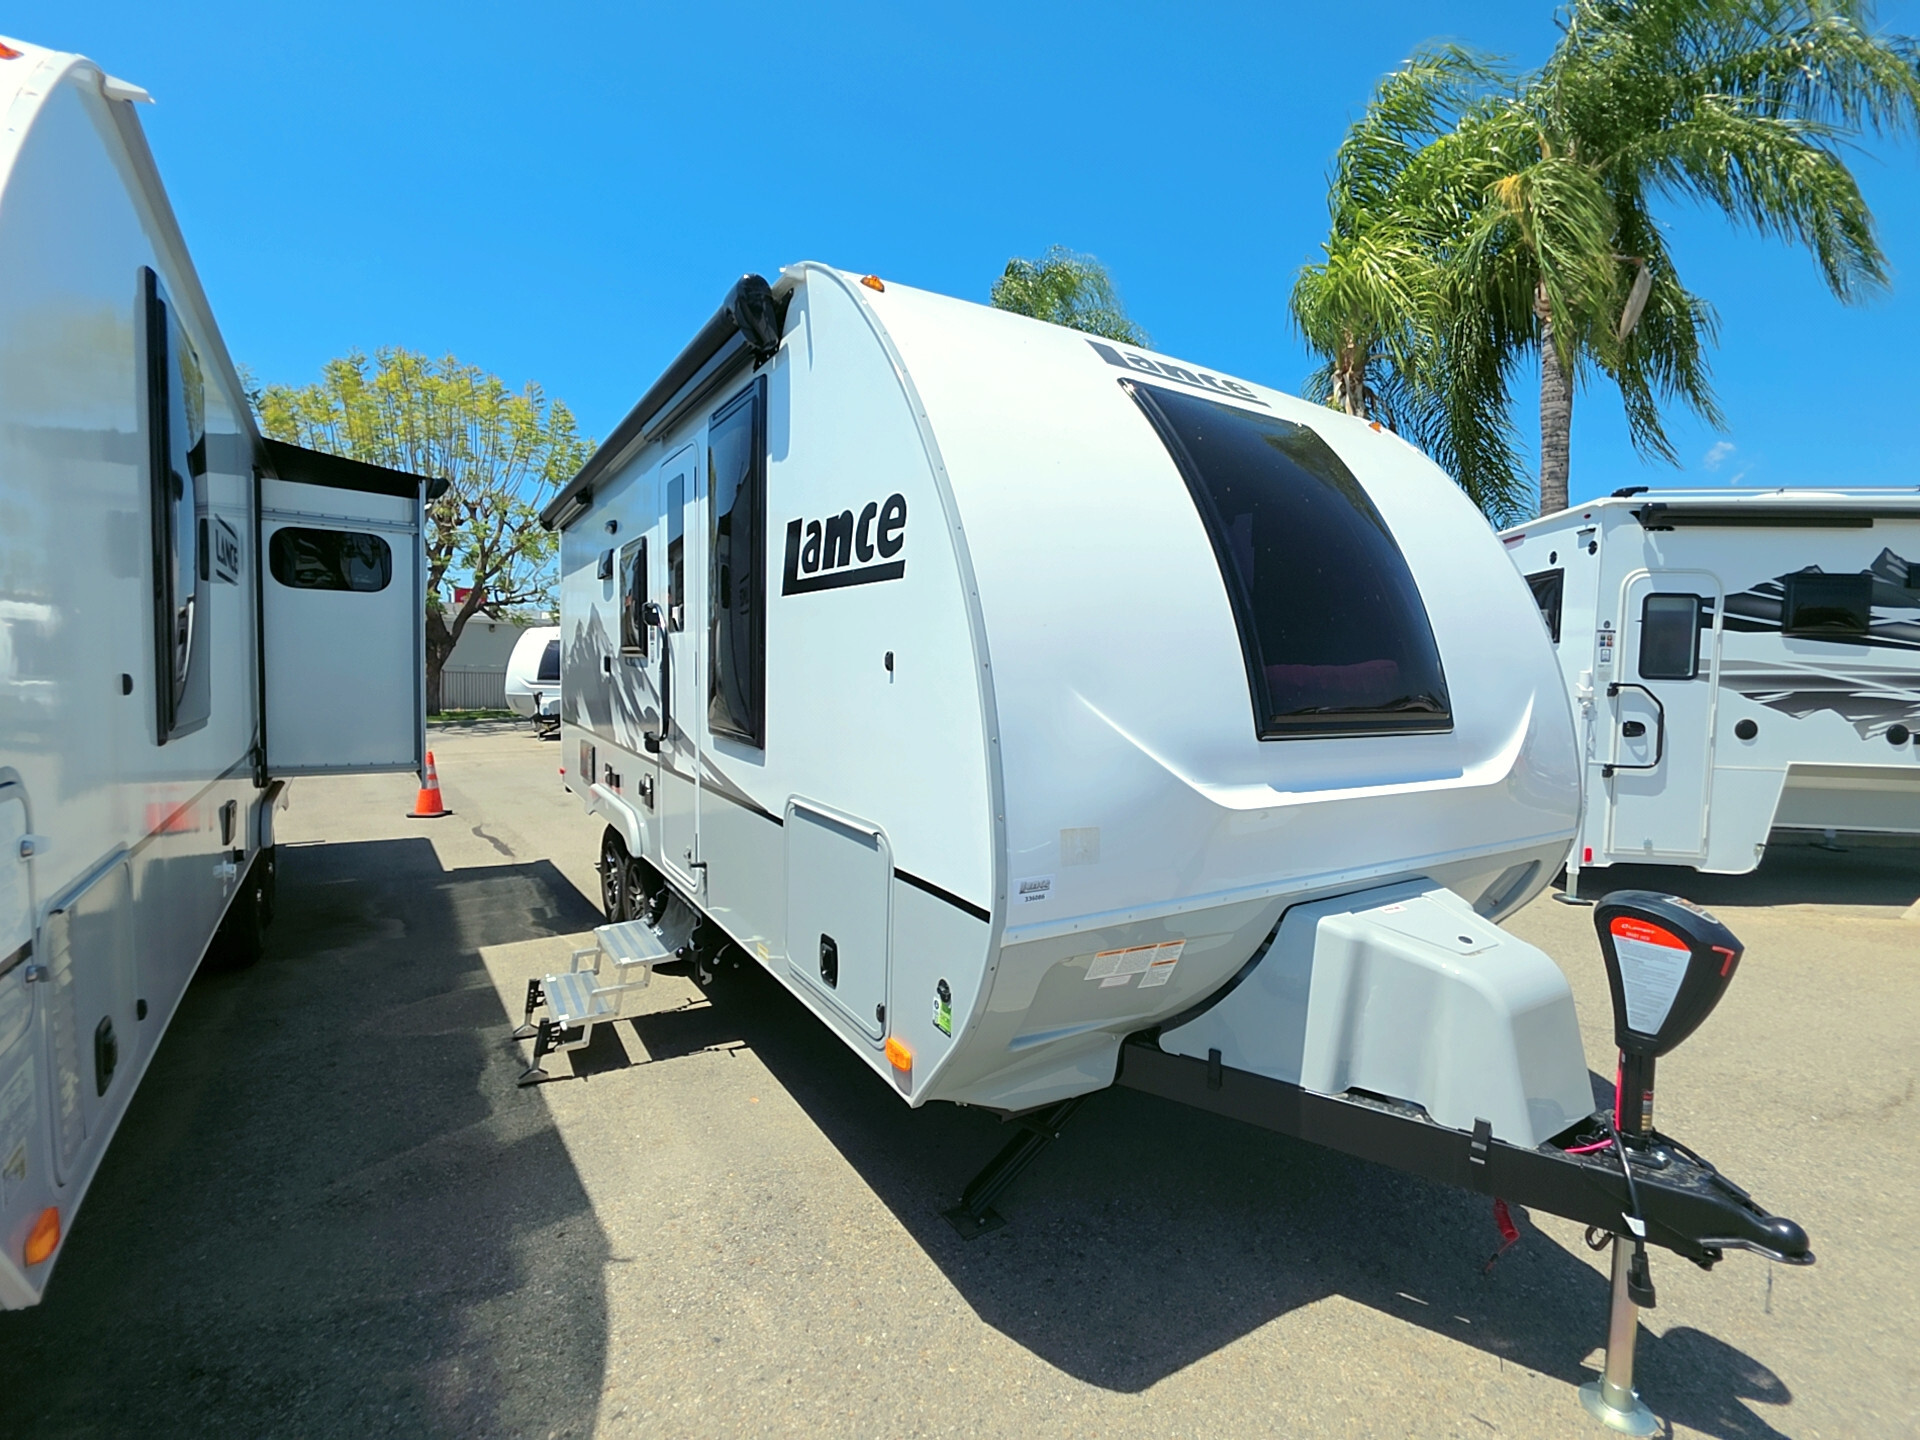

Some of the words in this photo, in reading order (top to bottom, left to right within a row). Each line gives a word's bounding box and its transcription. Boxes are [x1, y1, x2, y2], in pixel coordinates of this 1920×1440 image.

[1085, 338, 1272, 409] Lance
[215, 529, 238, 575] LANCE
[781, 493, 907, 597] Lance
